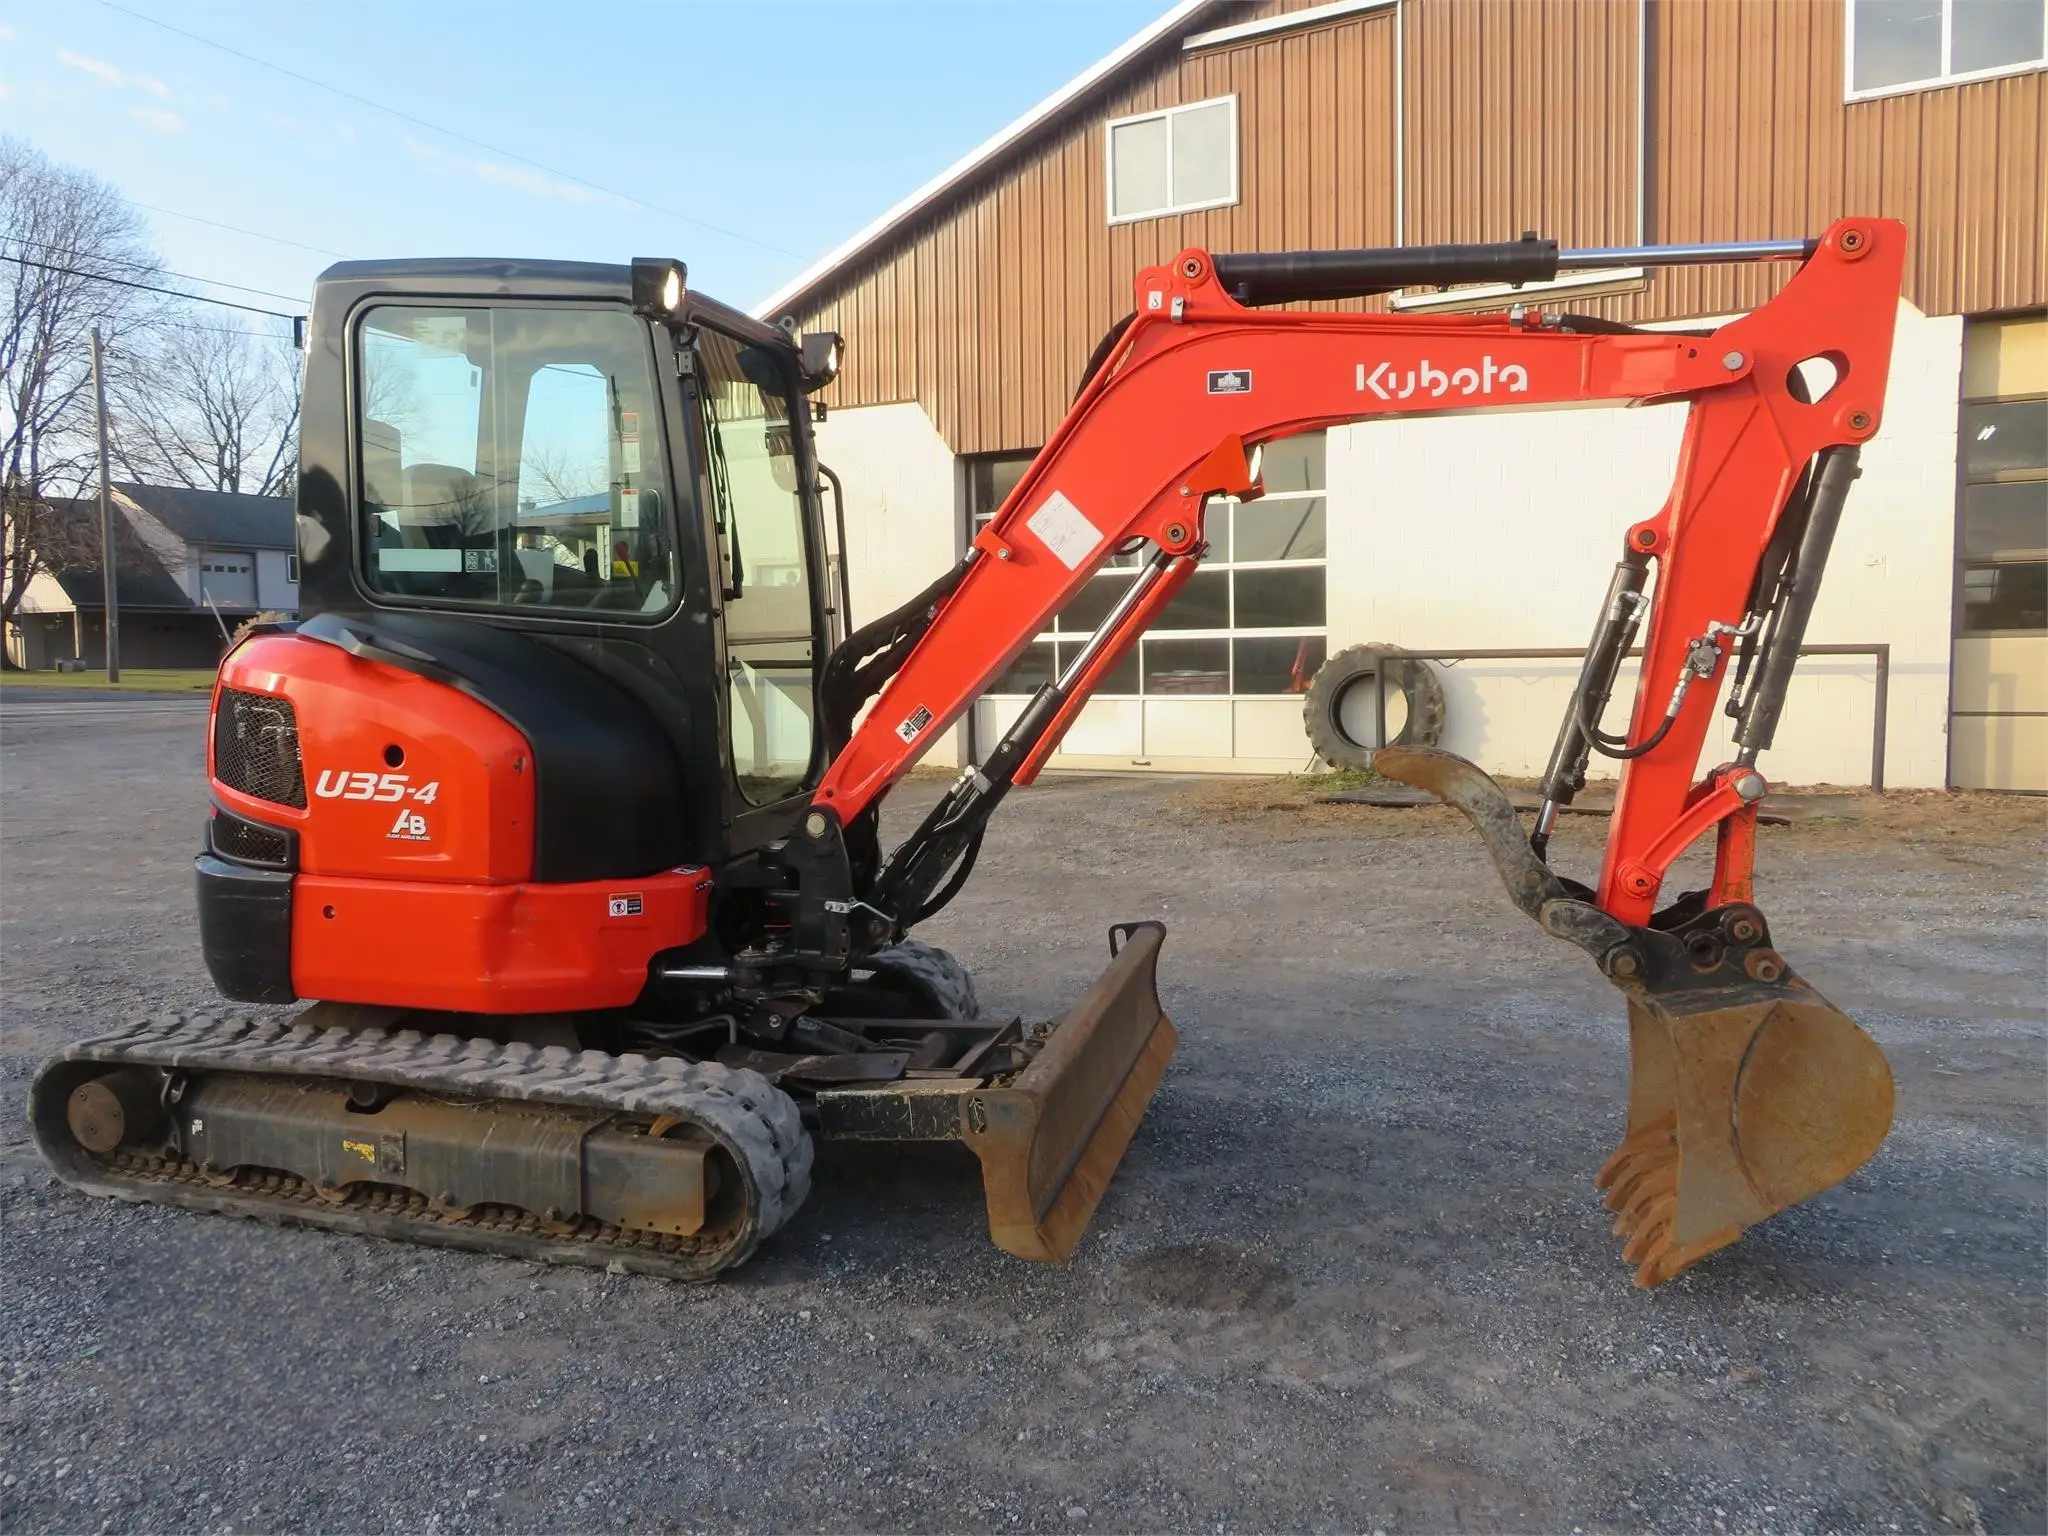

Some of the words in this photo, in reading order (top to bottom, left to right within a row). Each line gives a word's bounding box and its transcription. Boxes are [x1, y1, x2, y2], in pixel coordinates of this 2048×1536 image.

[1356, 356, 1527, 400] Kubota
[315, 769, 440, 805] U35-4
[391, 809, 427, 835] AB
